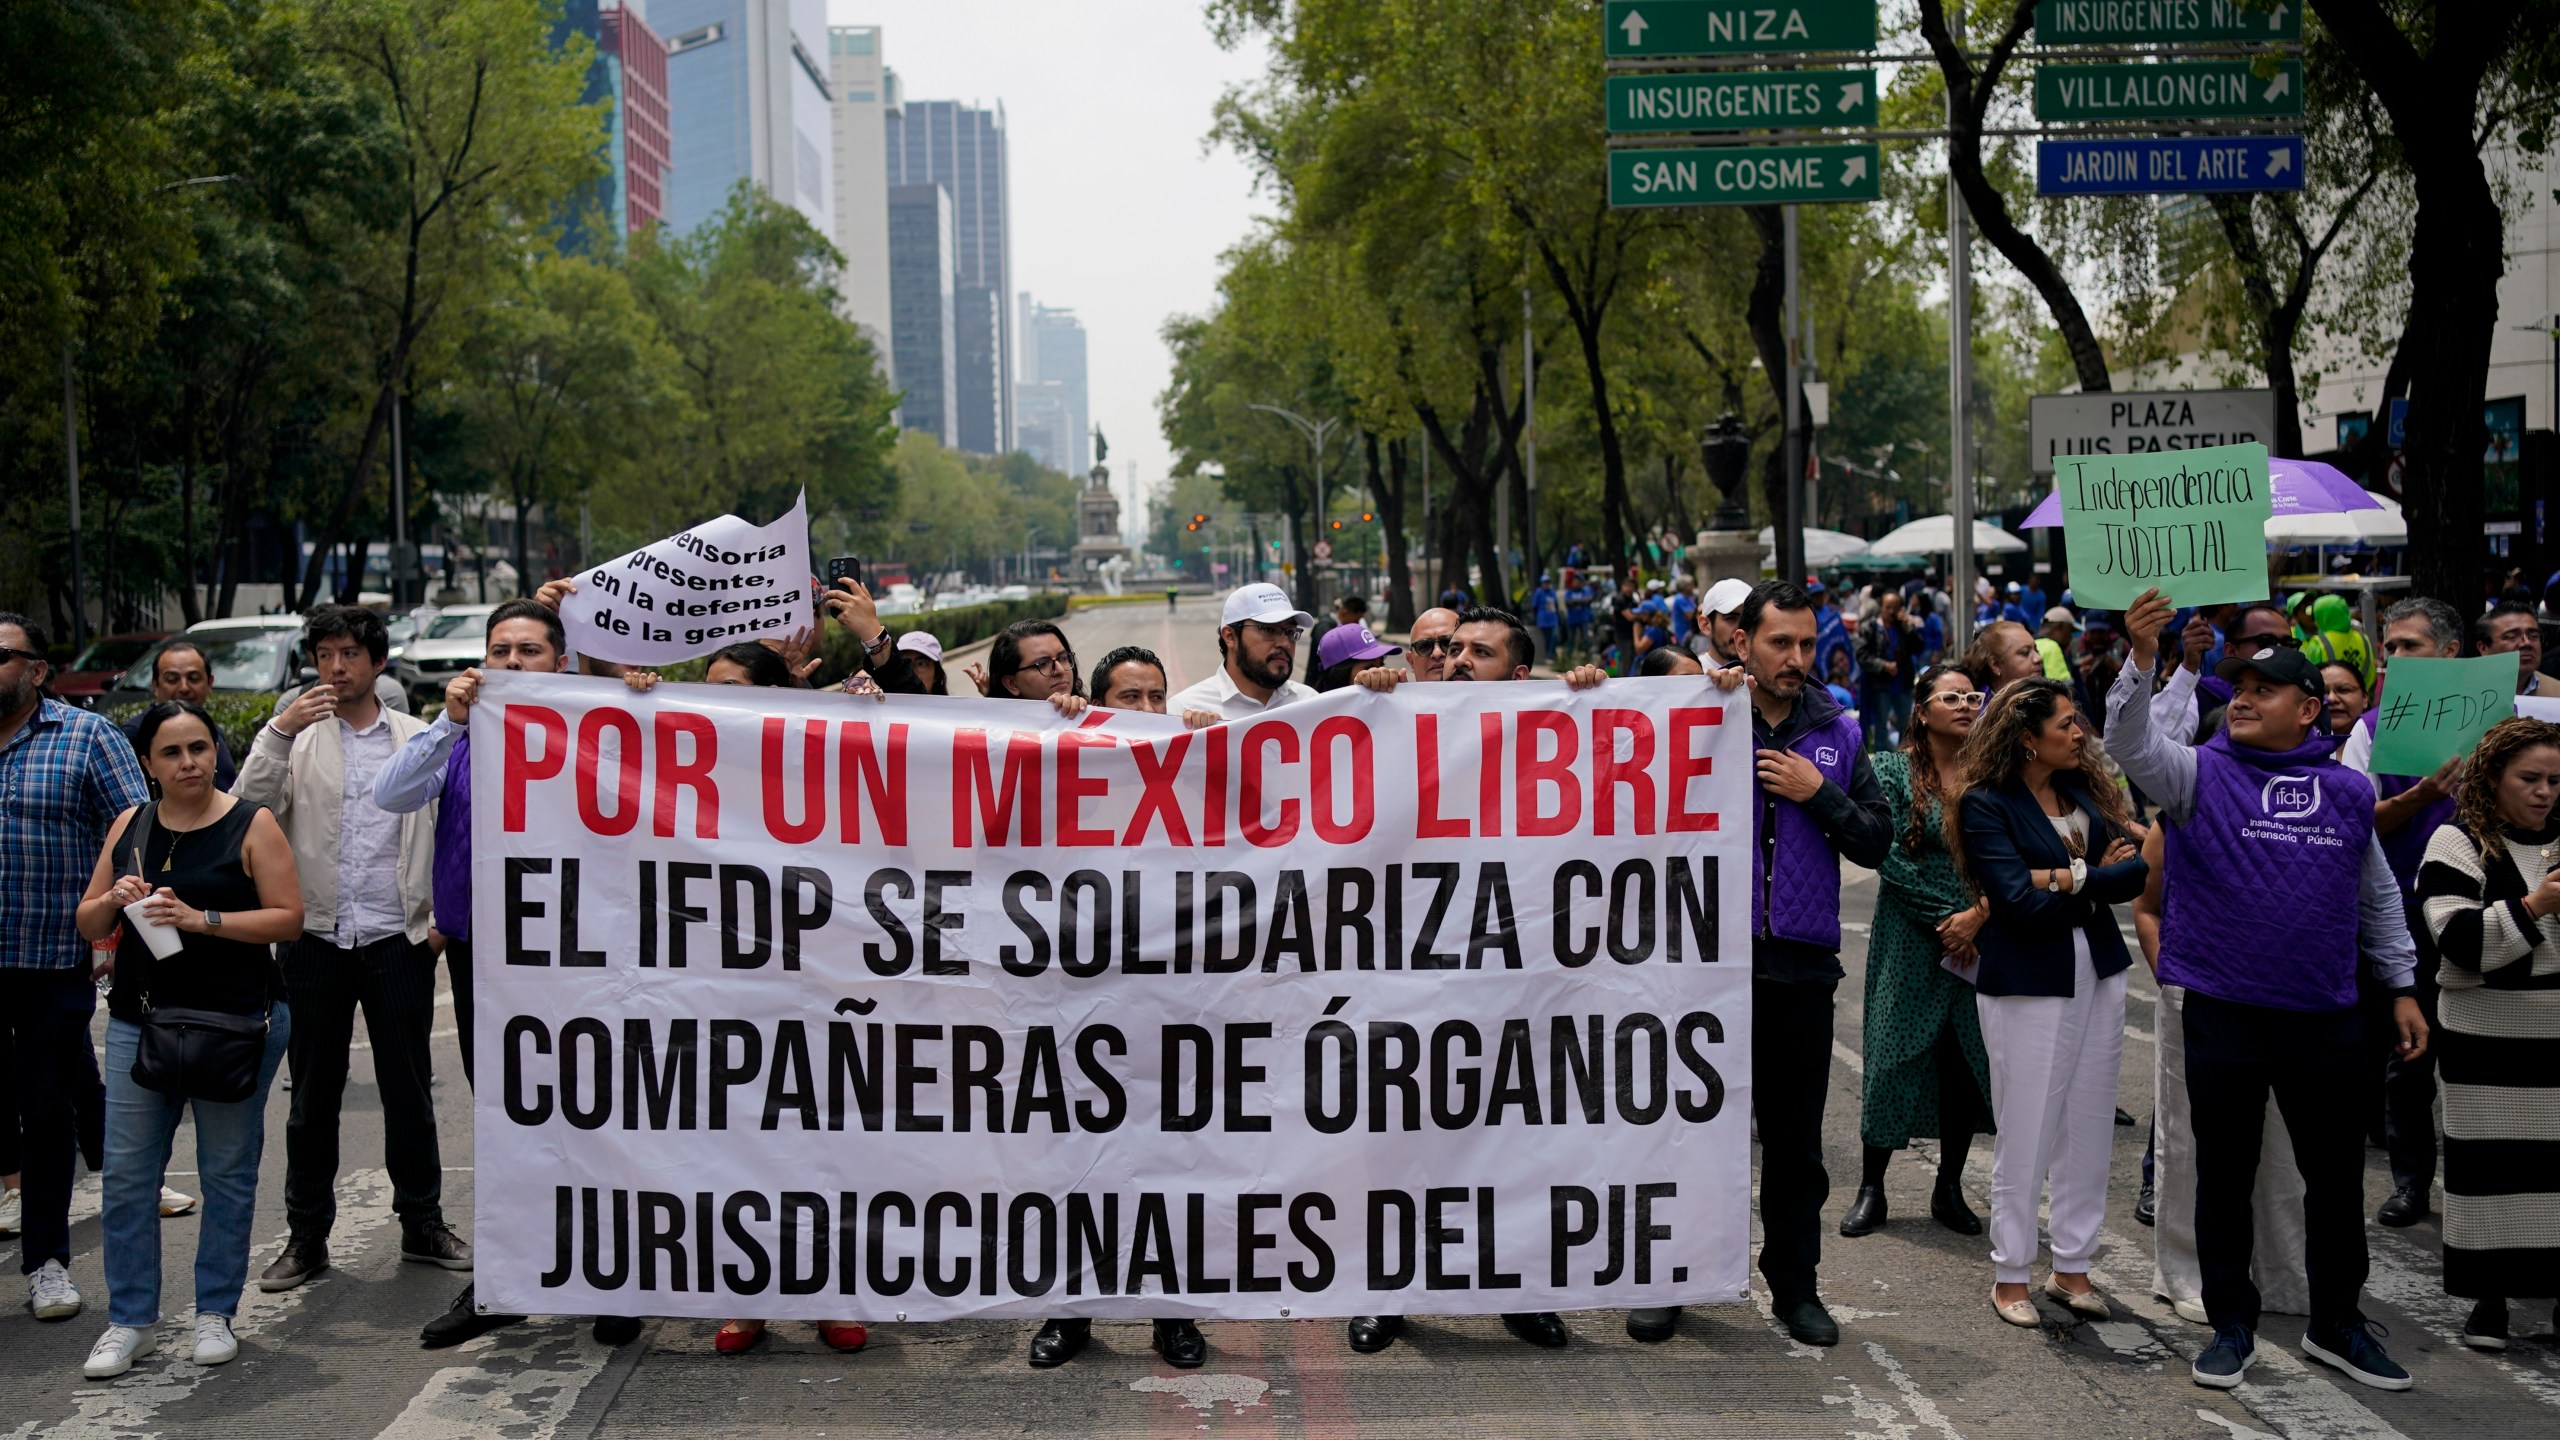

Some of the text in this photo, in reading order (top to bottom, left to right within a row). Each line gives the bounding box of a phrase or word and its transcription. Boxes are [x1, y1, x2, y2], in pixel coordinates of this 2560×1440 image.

[1708, 9, 1809, 42] NIZA
[2056, 0, 2200, 32] INSURGENTES
[1628, 83, 1821, 119] INSURGENTES
[2058, 73, 2247, 108] VILLALONGIN
[1632, 158, 1824, 193] SAN COSME
[2059, 148, 2248, 183] JARDIN DEL ARTE
[2111, 400, 2194, 428] PLAZA
[2069, 461, 2254, 521] Independencia
[2097, 521, 2247, 579] JUDICIAL
[627, 550, 775, 591] presente,
[592, 569, 800, 617] en la defensa
[594, 608, 792, 645] de la gente!
[2381, 689, 2498, 732] #IFDP
[504, 704, 1723, 848] POR UN MÉXICO LIBRE
[2276, 787, 2309, 809] ifdp
[2242, 828, 2343, 847] Defensoría Pública
[2250, 818, 2335, 834] Instituto Federal de
[505, 856, 1719, 978] EL IFDP SE SOLIDARIZA CON
[504, 997, 1724, 1134] COMPAÑERAS DE ÓRGANOS
[541, 1183, 1688, 1297] JURISDICCIONALES DEL PJF.
